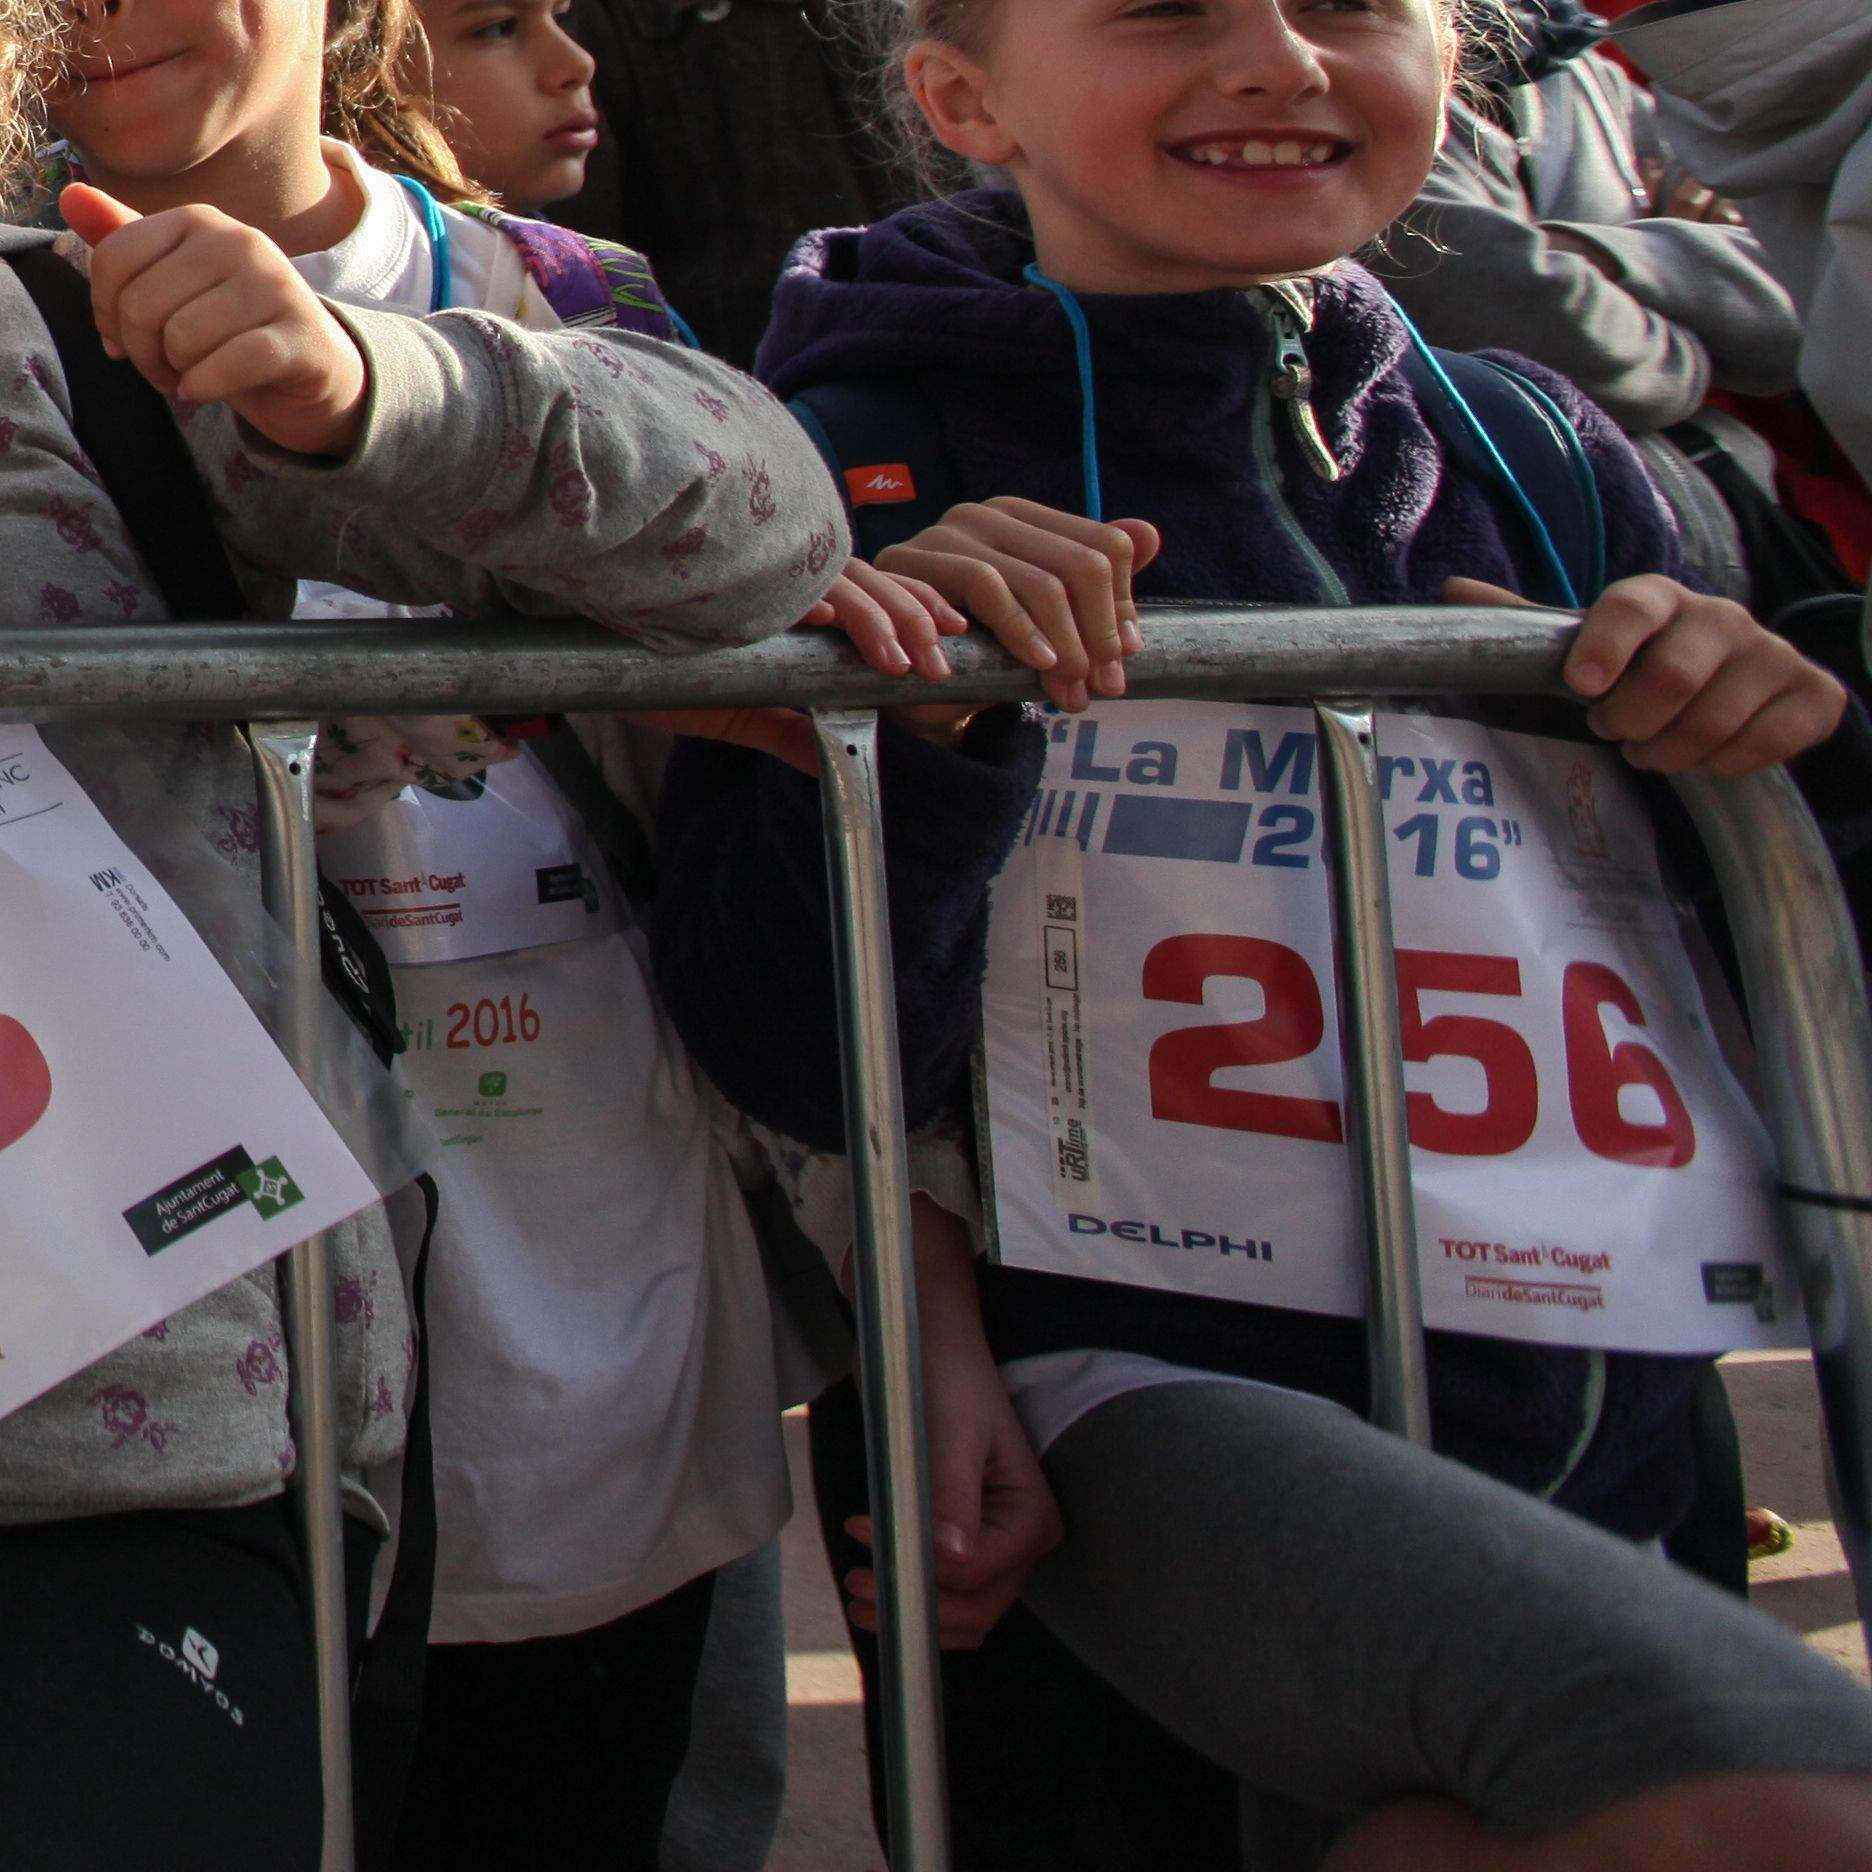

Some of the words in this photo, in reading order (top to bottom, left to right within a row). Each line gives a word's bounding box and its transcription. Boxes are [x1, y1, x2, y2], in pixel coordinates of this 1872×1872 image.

[1219, 728, 1494, 807] Mrxa
[1252, 804, 1521, 880] 216”
[380, 876, 422, 895] Sant
[429, 872, 466, 893] Cugat
[445, 991, 542, 1050] 2016
[1141, 932, 1696, 1169] 256
[156, 1168, 225, 1217] Ajuntament
[161, 1215, 177, 1234] de
[1067, 1212, 1273, 1261] DELPHI
[1439, 1238, 1492, 1262] TOT
[1494, 1242, 1540, 1266] Sant
[1551, 1246, 1611, 1274] Cugat
